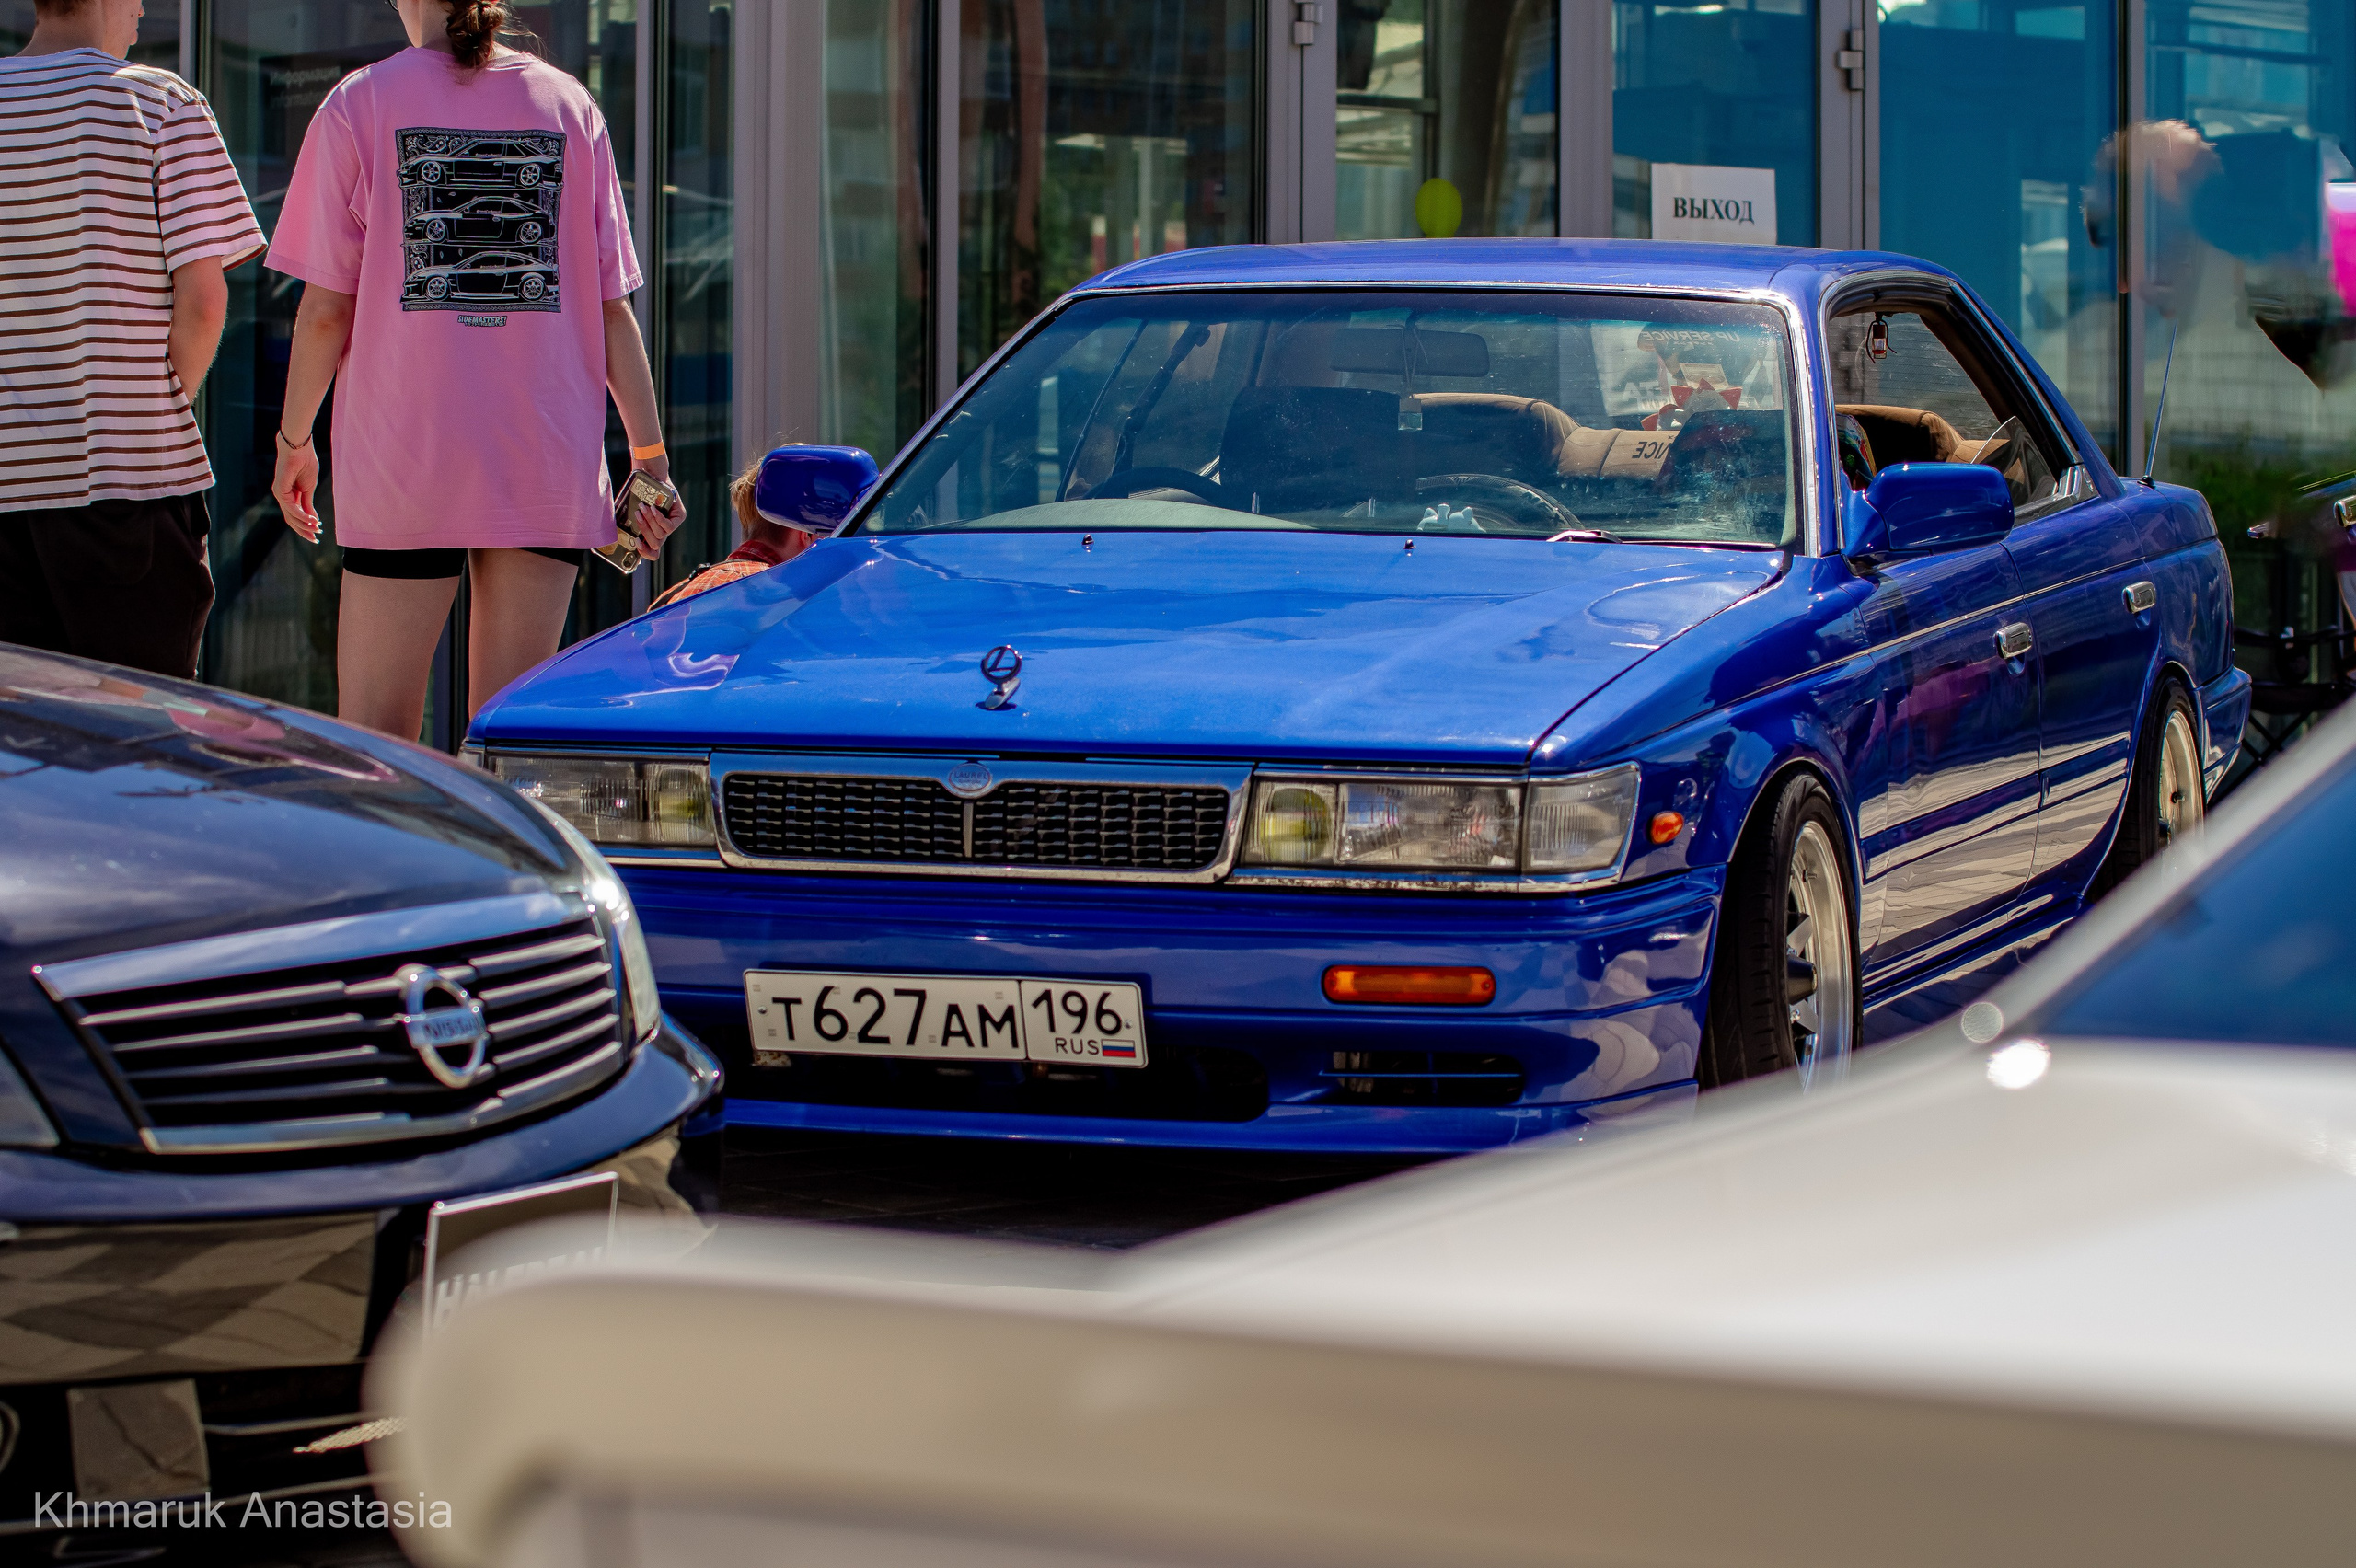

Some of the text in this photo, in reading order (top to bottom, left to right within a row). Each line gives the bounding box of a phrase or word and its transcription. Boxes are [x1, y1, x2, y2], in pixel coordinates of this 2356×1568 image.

[1673, 196, 1755, 225] ВЫХОД
[1032, 989, 1122, 1035] 196
[1055, 1037, 1100, 1055] RUS
